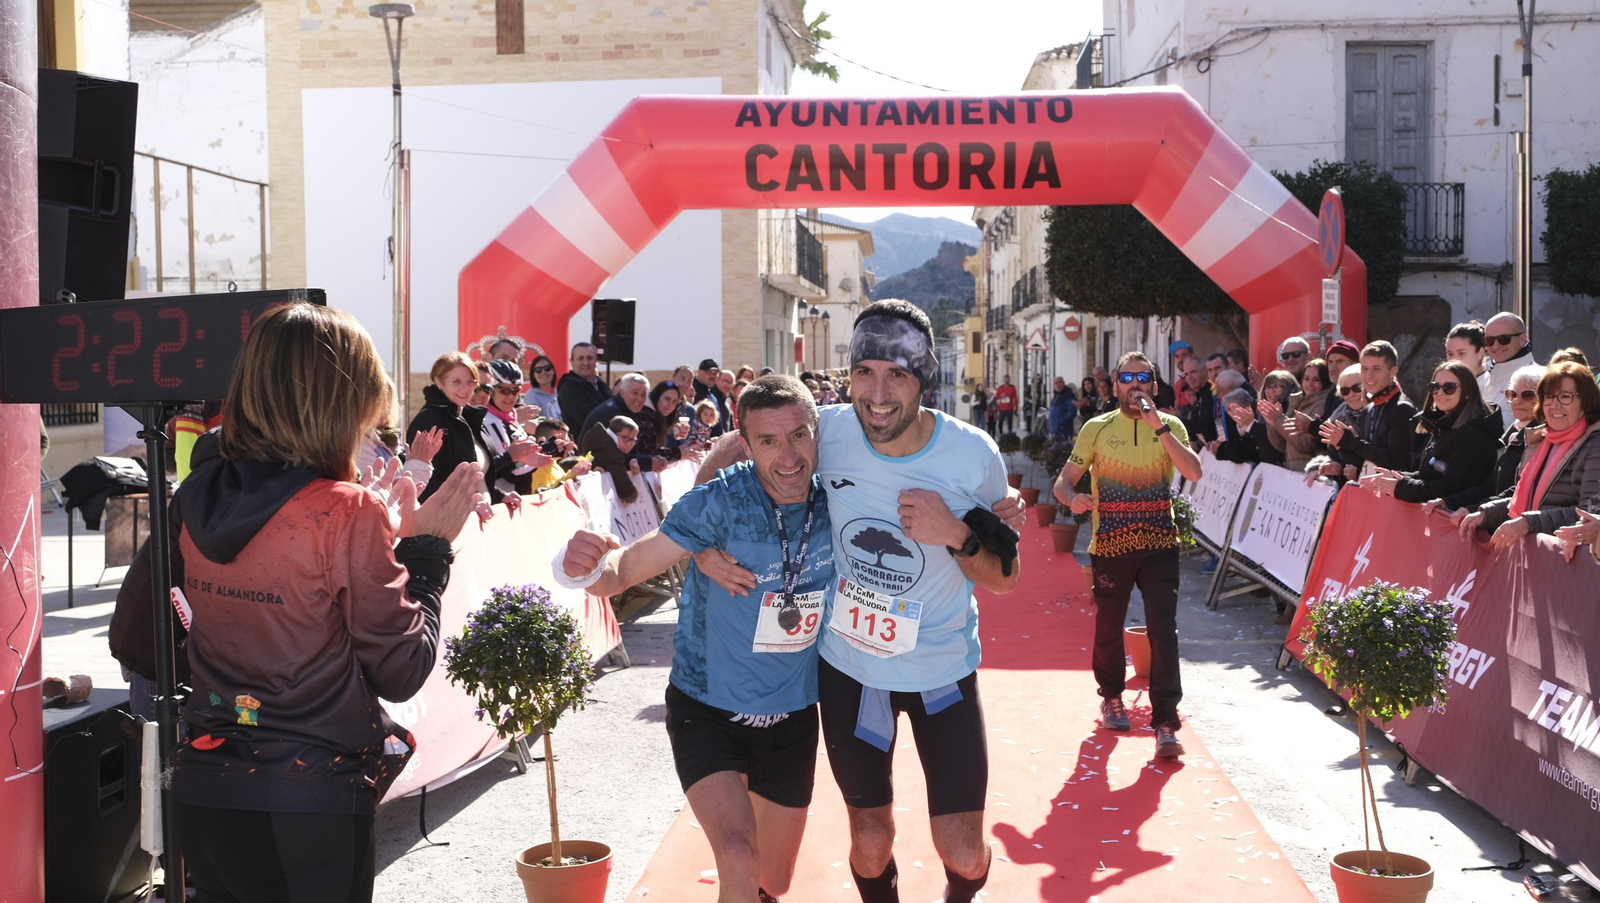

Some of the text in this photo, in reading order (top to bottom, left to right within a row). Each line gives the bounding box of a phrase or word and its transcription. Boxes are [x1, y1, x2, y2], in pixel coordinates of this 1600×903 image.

[735, 97, 1073, 127] AYUNTAMIENTO
[745, 141, 1062, 192] CANTORIA
[1310, 512, 1319, 527] DE
[1251, 507, 1312, 562] CANTORIA
[851, 559, 860, 570] LA
[860, 565, 913, 583] CARRASCA
[857, 573, 903, 591] LORCA TRAIL
[201, 581, 212, 593] DE
[216, 586, 284, 605] ALMANZORA
[844, 590, 887, 612] LA PÓLVORA
[847, 581, 875, 600] IV CxM
[849, 606, 897, 642] 113
